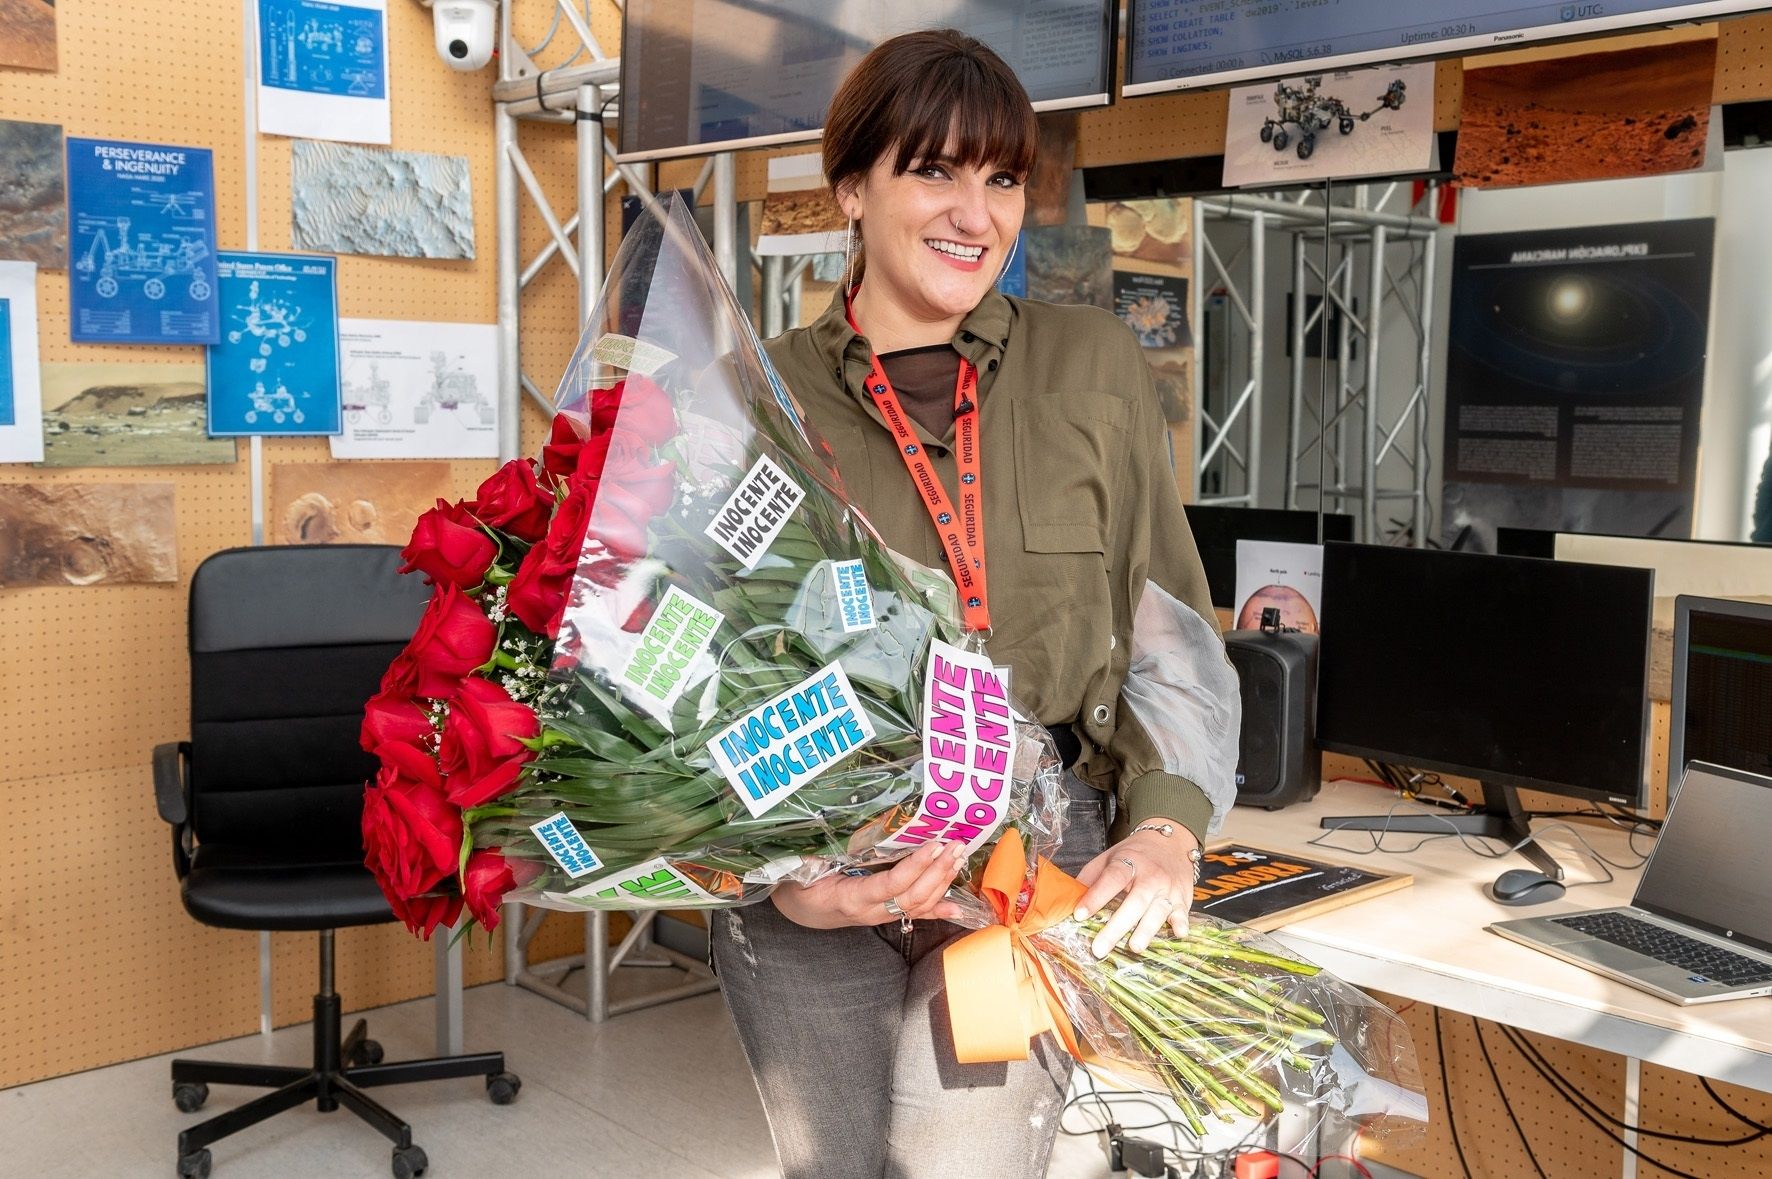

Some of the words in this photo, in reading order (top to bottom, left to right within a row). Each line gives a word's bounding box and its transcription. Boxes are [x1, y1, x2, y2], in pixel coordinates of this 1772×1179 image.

[1148, 24, 1169, 34] SHOW
[1173, 17, 1203, 30] CREATE
[1210, 12, 1235, 24] TABLE
[1148, 36, 1168, 46] SHOW
[1149, 9, 1179, 20] SELECT
[1493, 32, 1525, 41] Panasonic
[1148, 48, 1168, 58] SHOW
[1274, 49, 1304, 63] MySQL
[94, 146, 186, 165] PERSEVERANCE
[102, 159, 113, 171] &
[115, 160, 180, 175] INGENUITY
[882, 400, 909, 438] SEGURIDAD
[962, 417, 973, 464] SEGURIDAD
[714, 463, 781, 543] INOCENTE
[914, 462, 942, 506] SEGURIDAD
[731, 481, 799, 559] INOCENTE
[964, 493, 977, 548] SEGURIDAD
[948, 533, 974, 588] SEGURIDAD
[837, 566, 859, 627] INOCENTE
[850, 564, 872, 625] INOCENTE
[624, 593, 695, 687] INOCENTE
[645, 608, 717, 700] INOCENTE
[719, 672, 848, 768] INOCENTE
[738, 708, 865, 801] INOCENTE
[893, 654, 968, 845] INOCENTE
[940, 668, 1011, 847] NOCENTE
[537, 823, 583, 874] INOCENTE
[552, 816, 597, 869] INOCENTE
